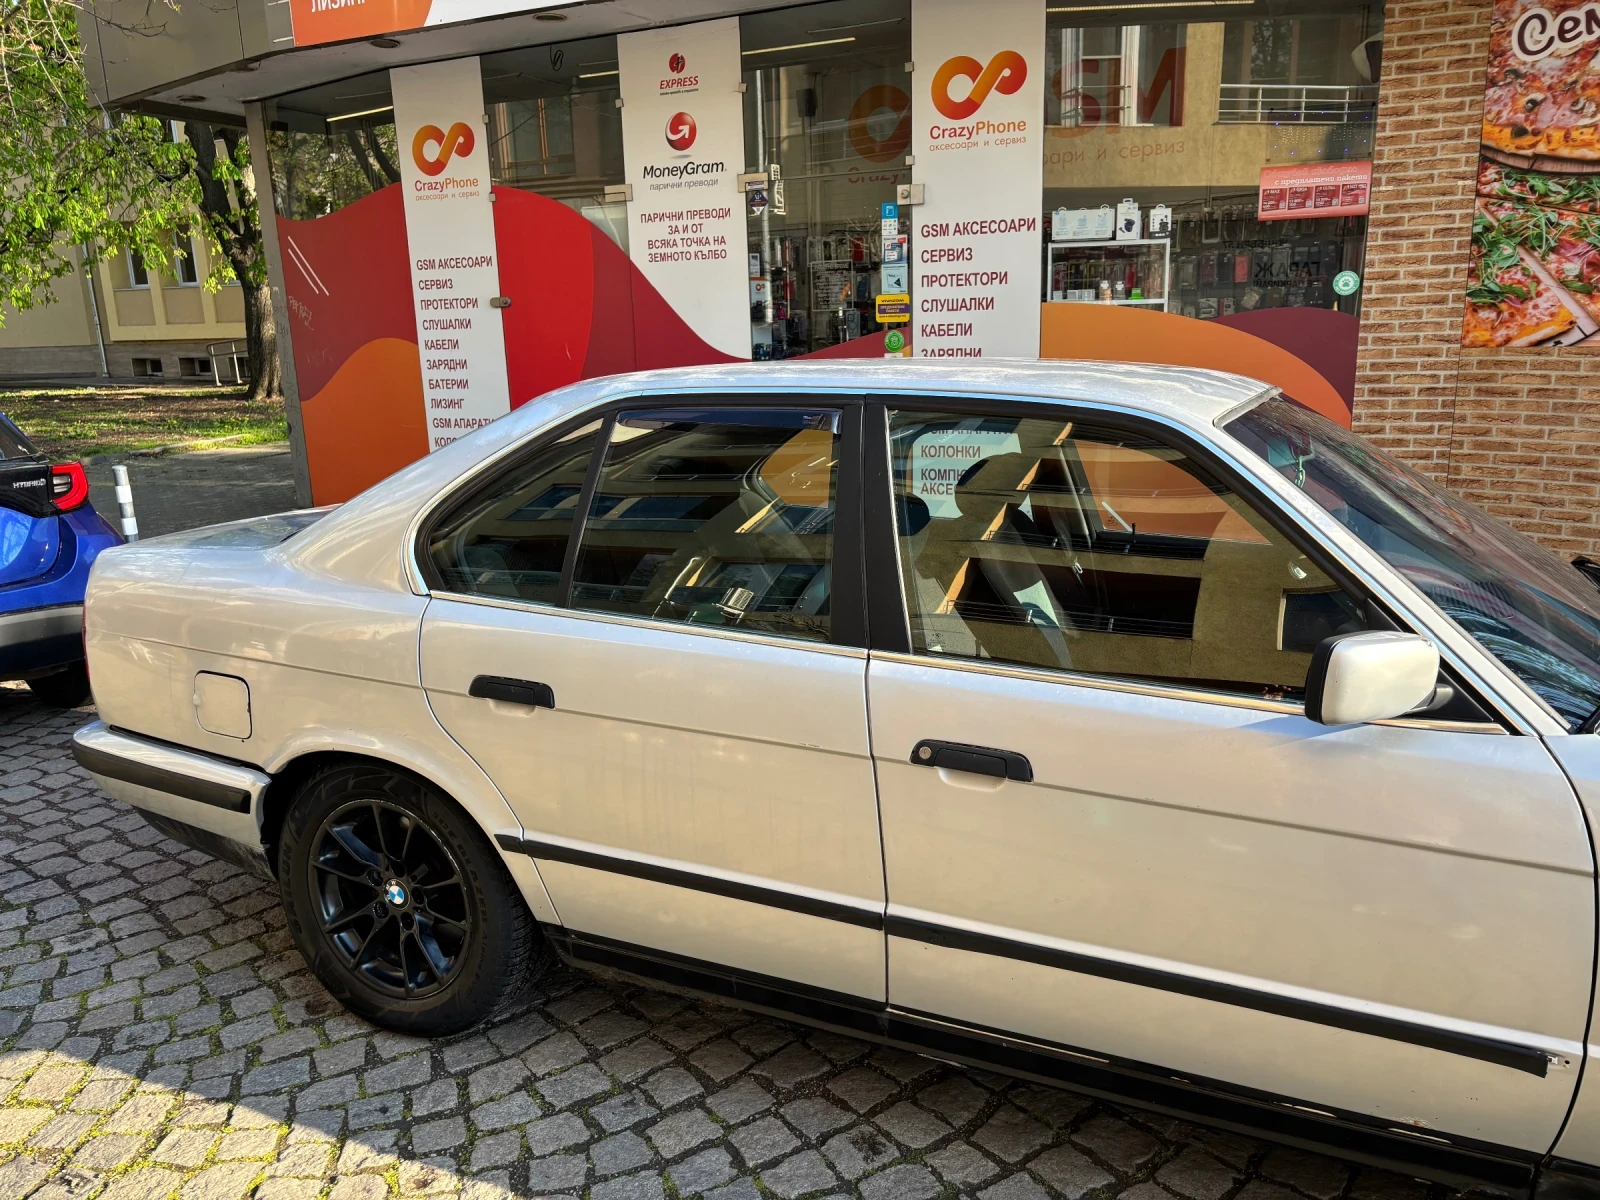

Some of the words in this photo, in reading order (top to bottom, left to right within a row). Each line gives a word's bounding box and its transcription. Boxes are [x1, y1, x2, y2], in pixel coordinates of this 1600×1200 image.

[660, 76, 699, 90] EXPRESS
[929, 120, 1027, 140] CrazyPhone
[929, 141, 979, 152] аксесоари
[994, 136, 1027, 148] сервиз
[1096, 148, 1107, 160] и
[1119, 141, 1185, 162] сервиз
[643, 161, 725, 179] MoneyGram
[414, 177, 479, 192] CrazyPhone
[649, 181, 683, 191] парични
[684, 179, 719, 189] преводи
[415, 193, 449, 201] аксесоари
[458, 191, 480, 199] сервиз
[640, 211, 684, 223] ПАРИЧНИ
[686, 207, 731, 220] ПРЕВОДИ
[668, 224, 680, 235] ЗА
[682, 224, 689, 234] И
[691, 223, 703, 233] ОТ
[920, 223, 950, 238] GSM
[953, 217, 1036, 236] АКСЕСОАРИ
[647, 238, 678, 249] ВСЯКА
[680, 236, 711, 247] ТОЧКА
[713, 235, 727, 246] НА
[648, 251, 692, 263] ЗЕМНОТО
[694, 249, 727, 260] КЪЛБО
[920, 247, 973, 264] СЕРВИЗ
[416, 259, 436, 271] GSM
[438, 255, 493, 270] АКСЕСОАРИ
[418, 278, 454, 291] СЕРВИЗ
[921, 271, 1008, 288] ПРОТЕКТОРИ
[420, 297, 479, 311] ПРОТЕКТОРИ
[921, 297, 995, 312] СЛУШАЛКИ
[422, 318, 472, 331] СЛУШАЛКИ
[921, 323, 973, 338] КАБЕЛИ
[424, 339, 460, 350] КАБЕЛИ
[426, 359, 468, 372] ЗАРЯДНИ
[428, 379, 469, 390] БАТЕРИИ
[430, 398, 465, 410] ЛИЗИНГ
[432, 418, 452, 429] GSM
[921, 445, 981, 459] КОЛОНКИ
[13, 480, 41, 489] HYBRID
[920, 482, 956, 495] АКСЕ
